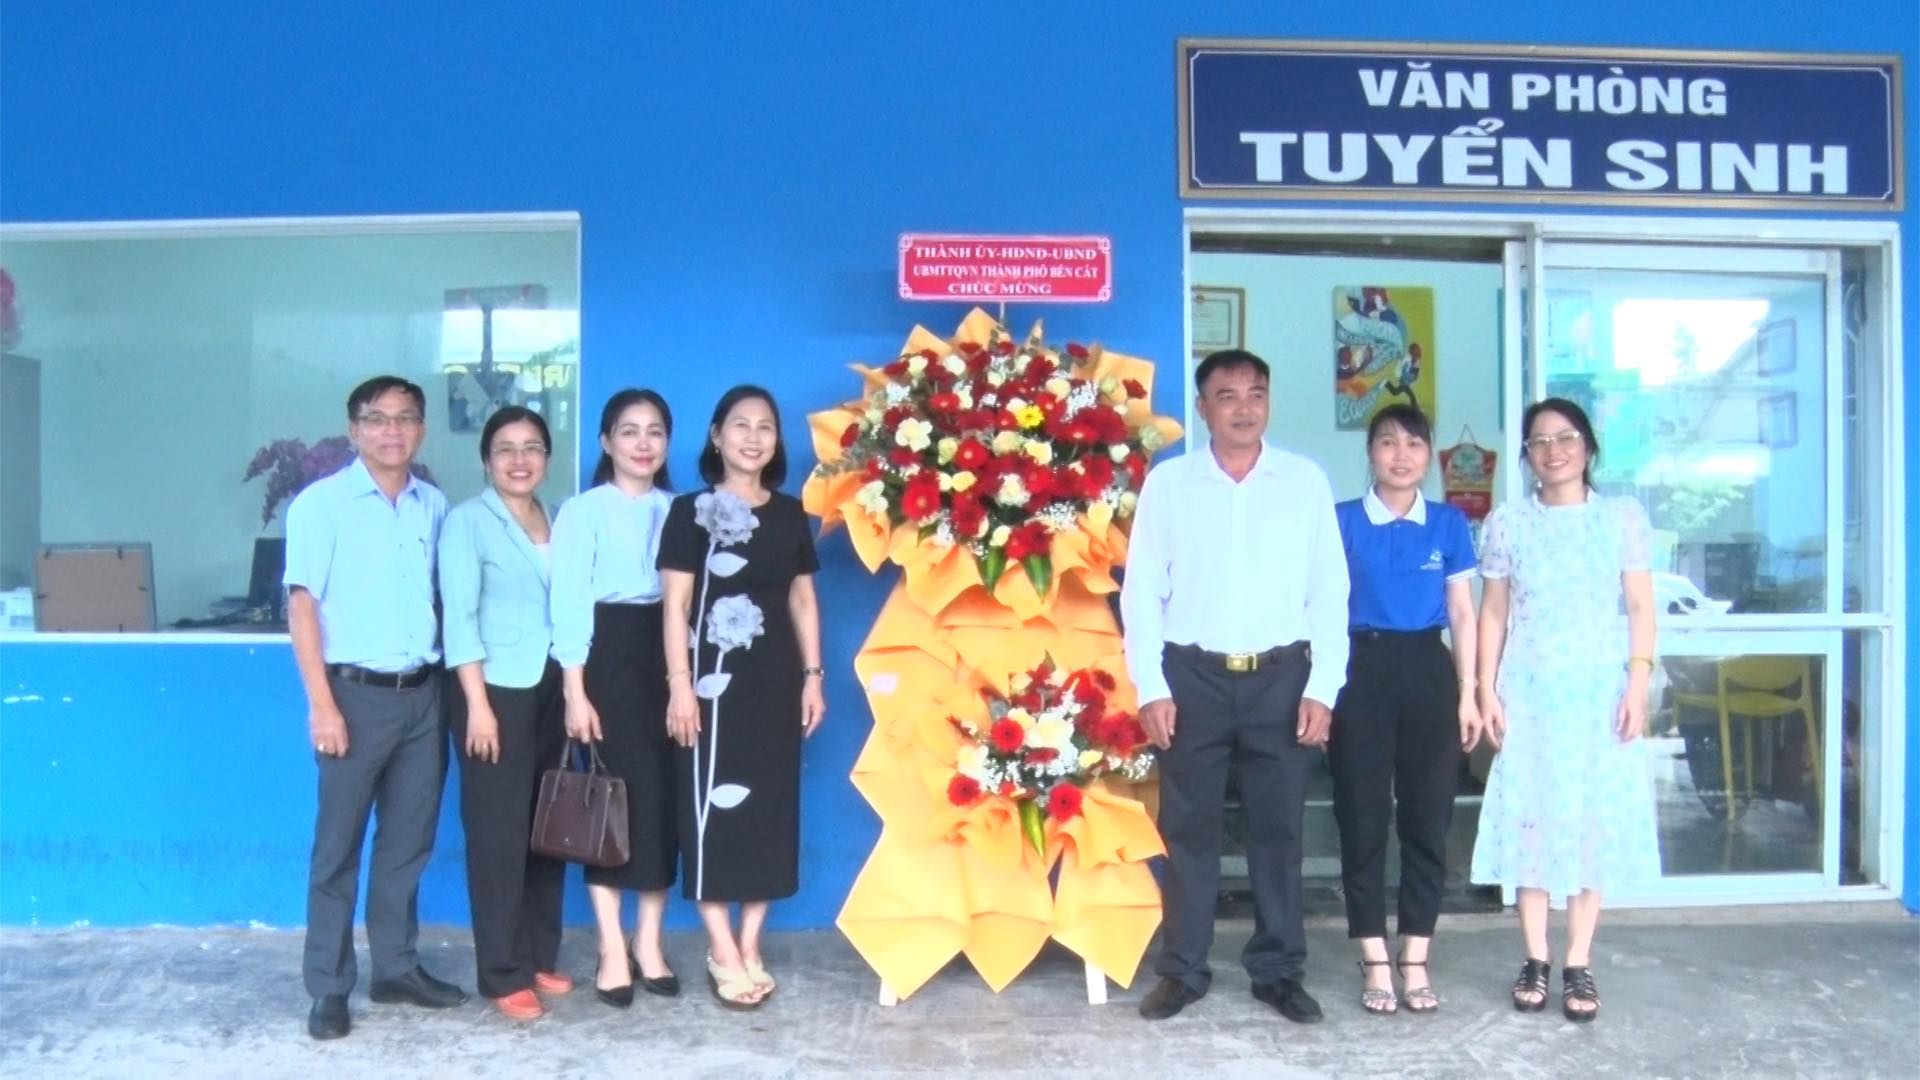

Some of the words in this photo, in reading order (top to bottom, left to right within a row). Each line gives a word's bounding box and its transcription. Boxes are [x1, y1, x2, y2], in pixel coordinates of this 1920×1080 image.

[1357, 60, 1490, 110] VĂN
[1510, 67, 1727, 117] PHÒNG
[1239, 118, 1573, 188] TUYỂN
[1604, 139, 1849, 194] SINH
[913, 243, 971, 258] THÀNH
[913, 265, 978, 279] UBMTTQVN
[980, 262, 1021, 278] THÀNH
